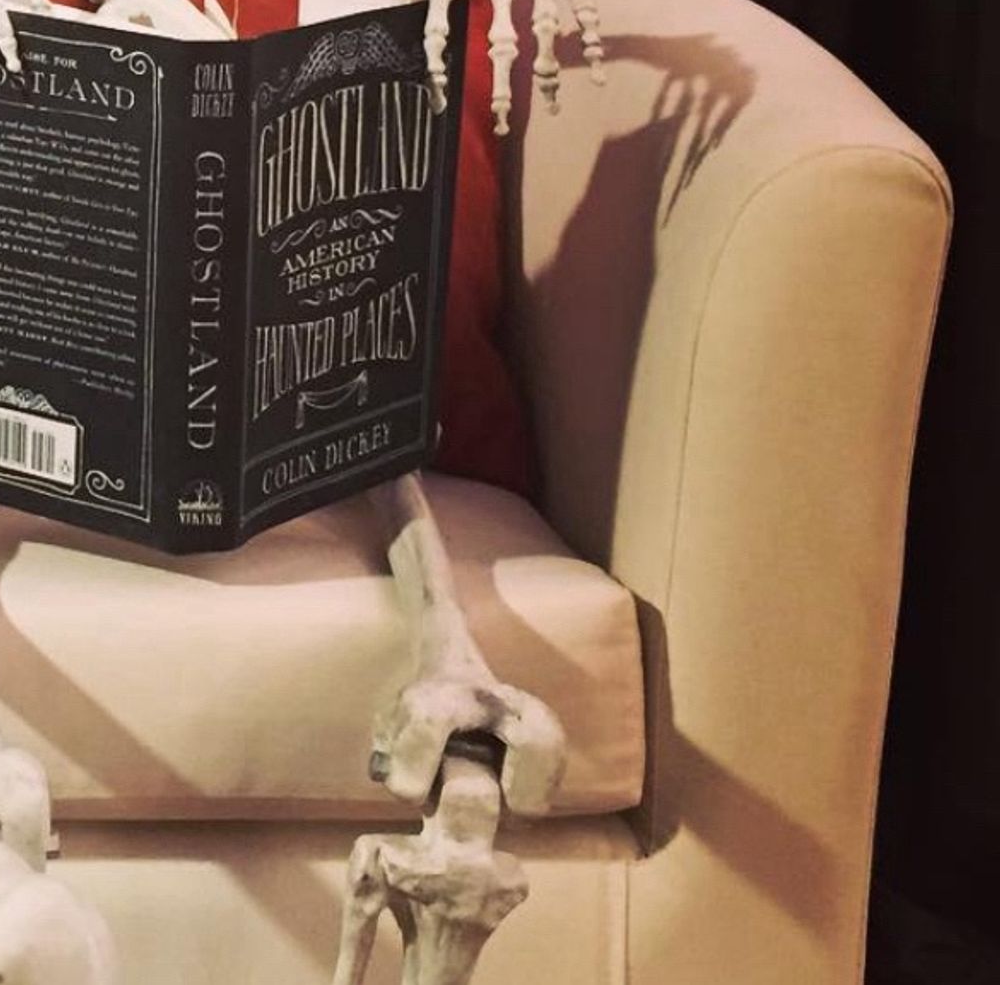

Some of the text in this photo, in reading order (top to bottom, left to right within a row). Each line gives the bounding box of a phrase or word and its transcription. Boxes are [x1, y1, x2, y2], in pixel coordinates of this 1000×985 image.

[194, 63, 234, 91] COLIN
[257, 81, 432, 237] GHOSTLAND
[279, 226, 397, 276] AMERICAN
[287, 250, 381, 295] HISTORY
[187, 150, 226, 450] GHOSTLAND
[328, 282, 345, 301] IN
[253, 316, 335, 421] HAUNTED
[341, 273, 420, 367] PLACES
[262, 422, 393, 495] COLIN DICKEY
[179, 512, 222, 526] VIKING
